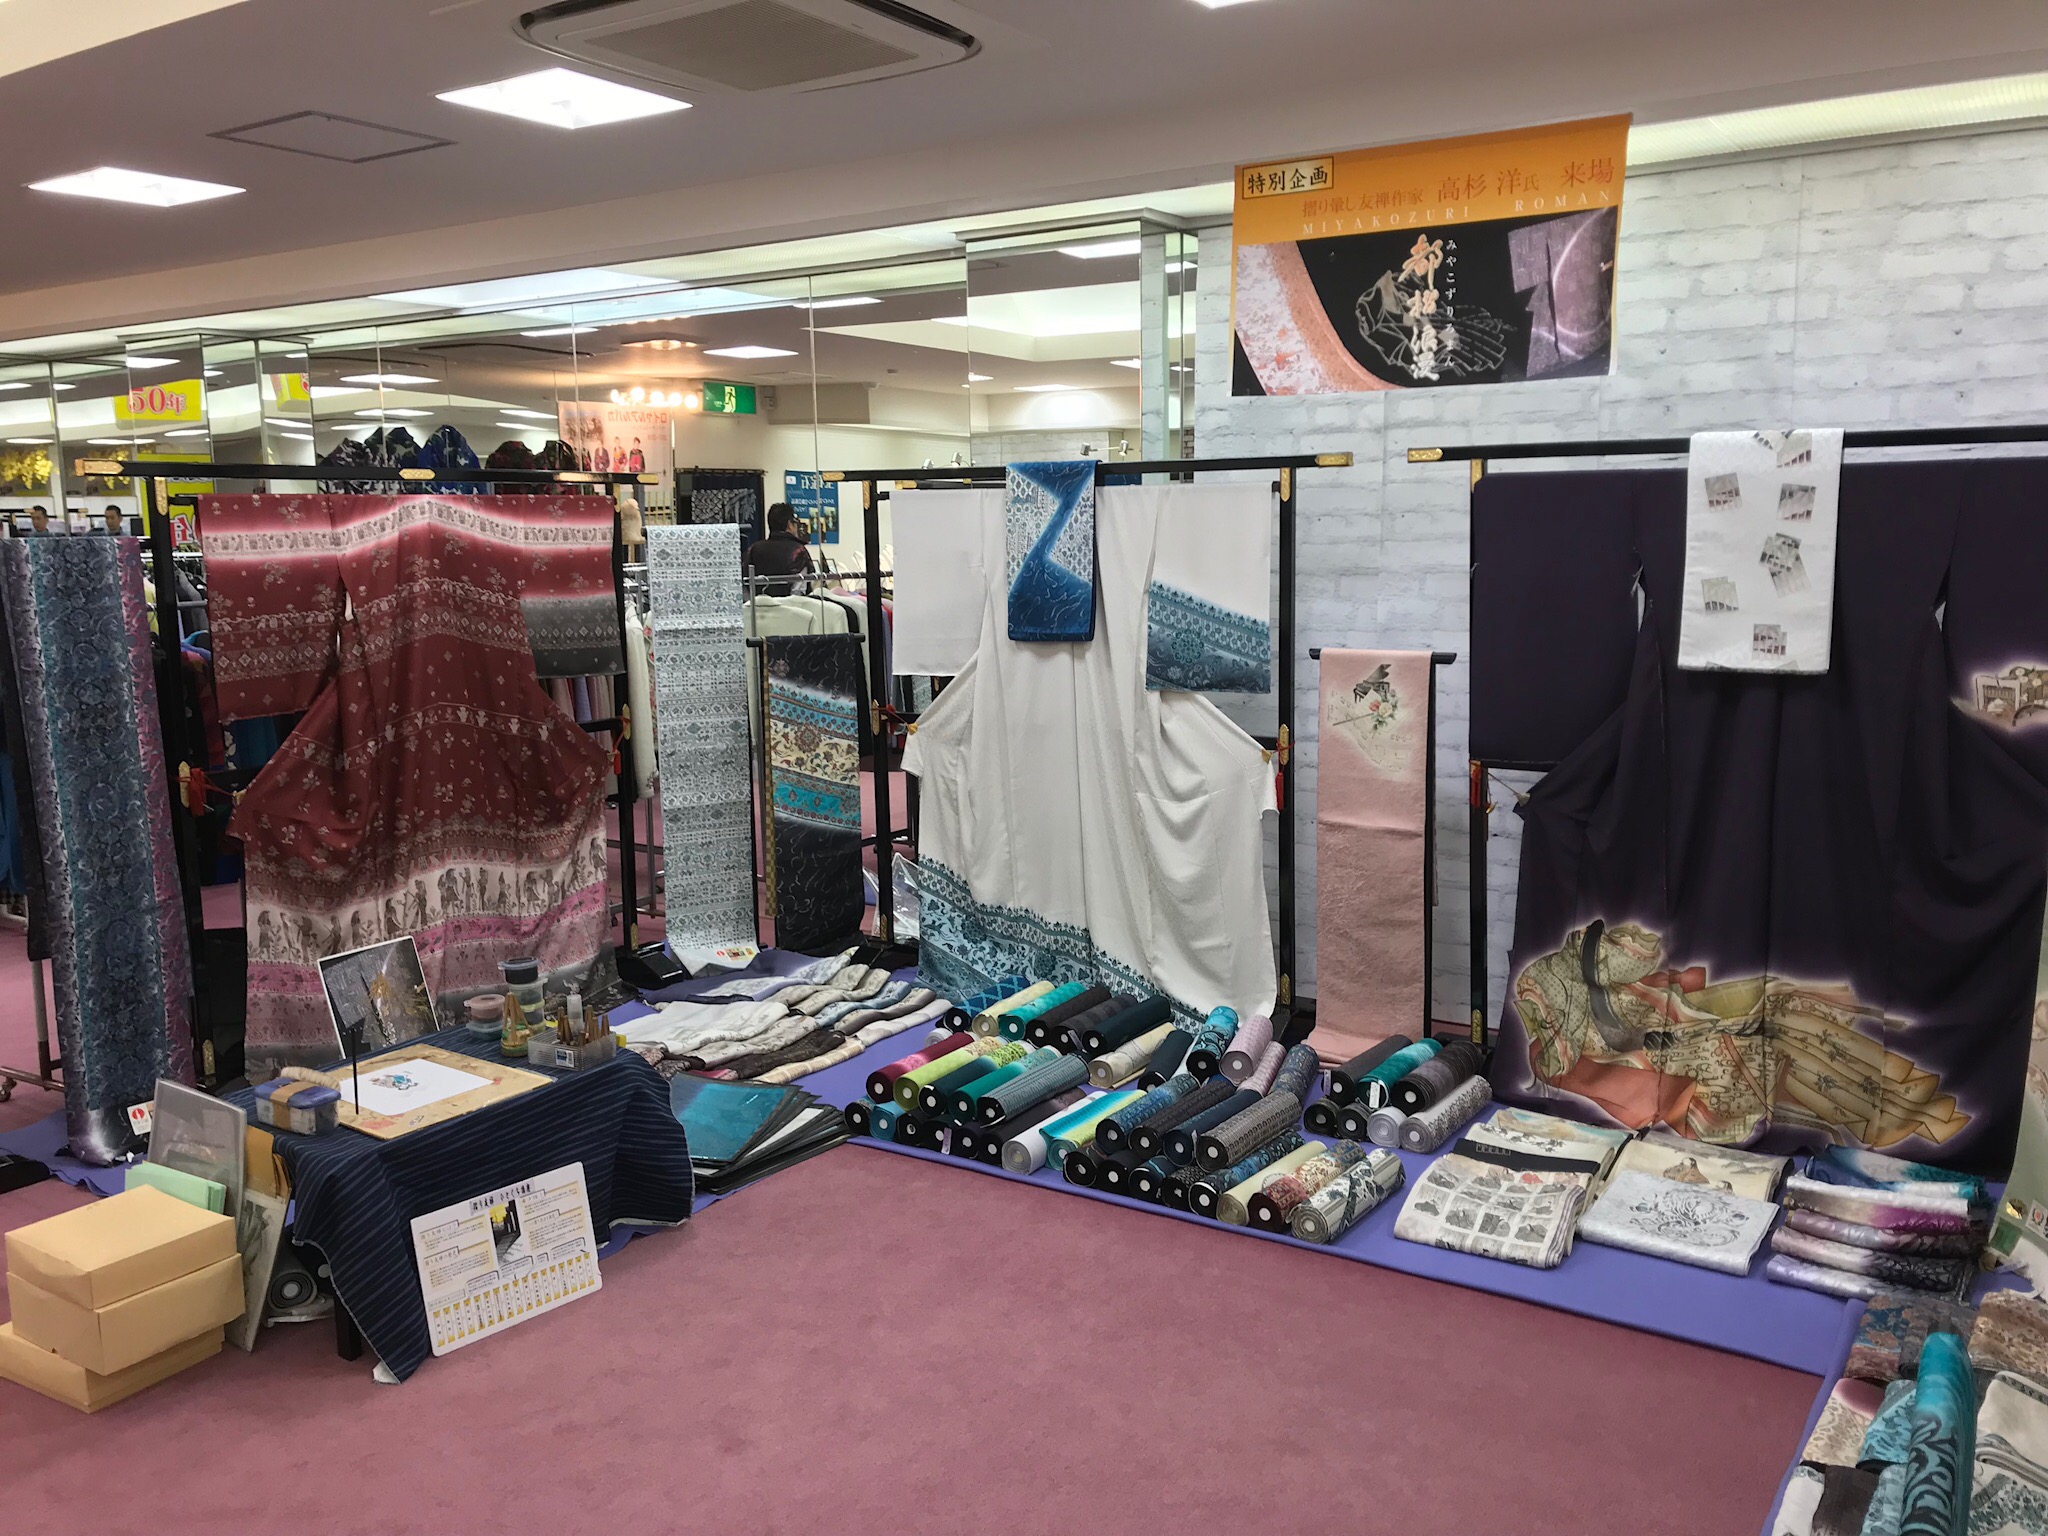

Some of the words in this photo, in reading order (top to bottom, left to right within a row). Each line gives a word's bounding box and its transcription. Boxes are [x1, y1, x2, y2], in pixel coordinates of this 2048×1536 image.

[1247, 165, 1328, 195] 特別企画
[1438, 173, 1487, 203] 高杉
[1497, 167, 1540, 197] 洋氏
[1560, 157, 1615, 188] 来場
[1302, 206, 1469, 235] MIYAKOZURI
[1514, 190, 1611, 212] ROMAN
[1445, 239, 1458, 366] みやこずりろまん
[128, 386, 186, 416] 50年
